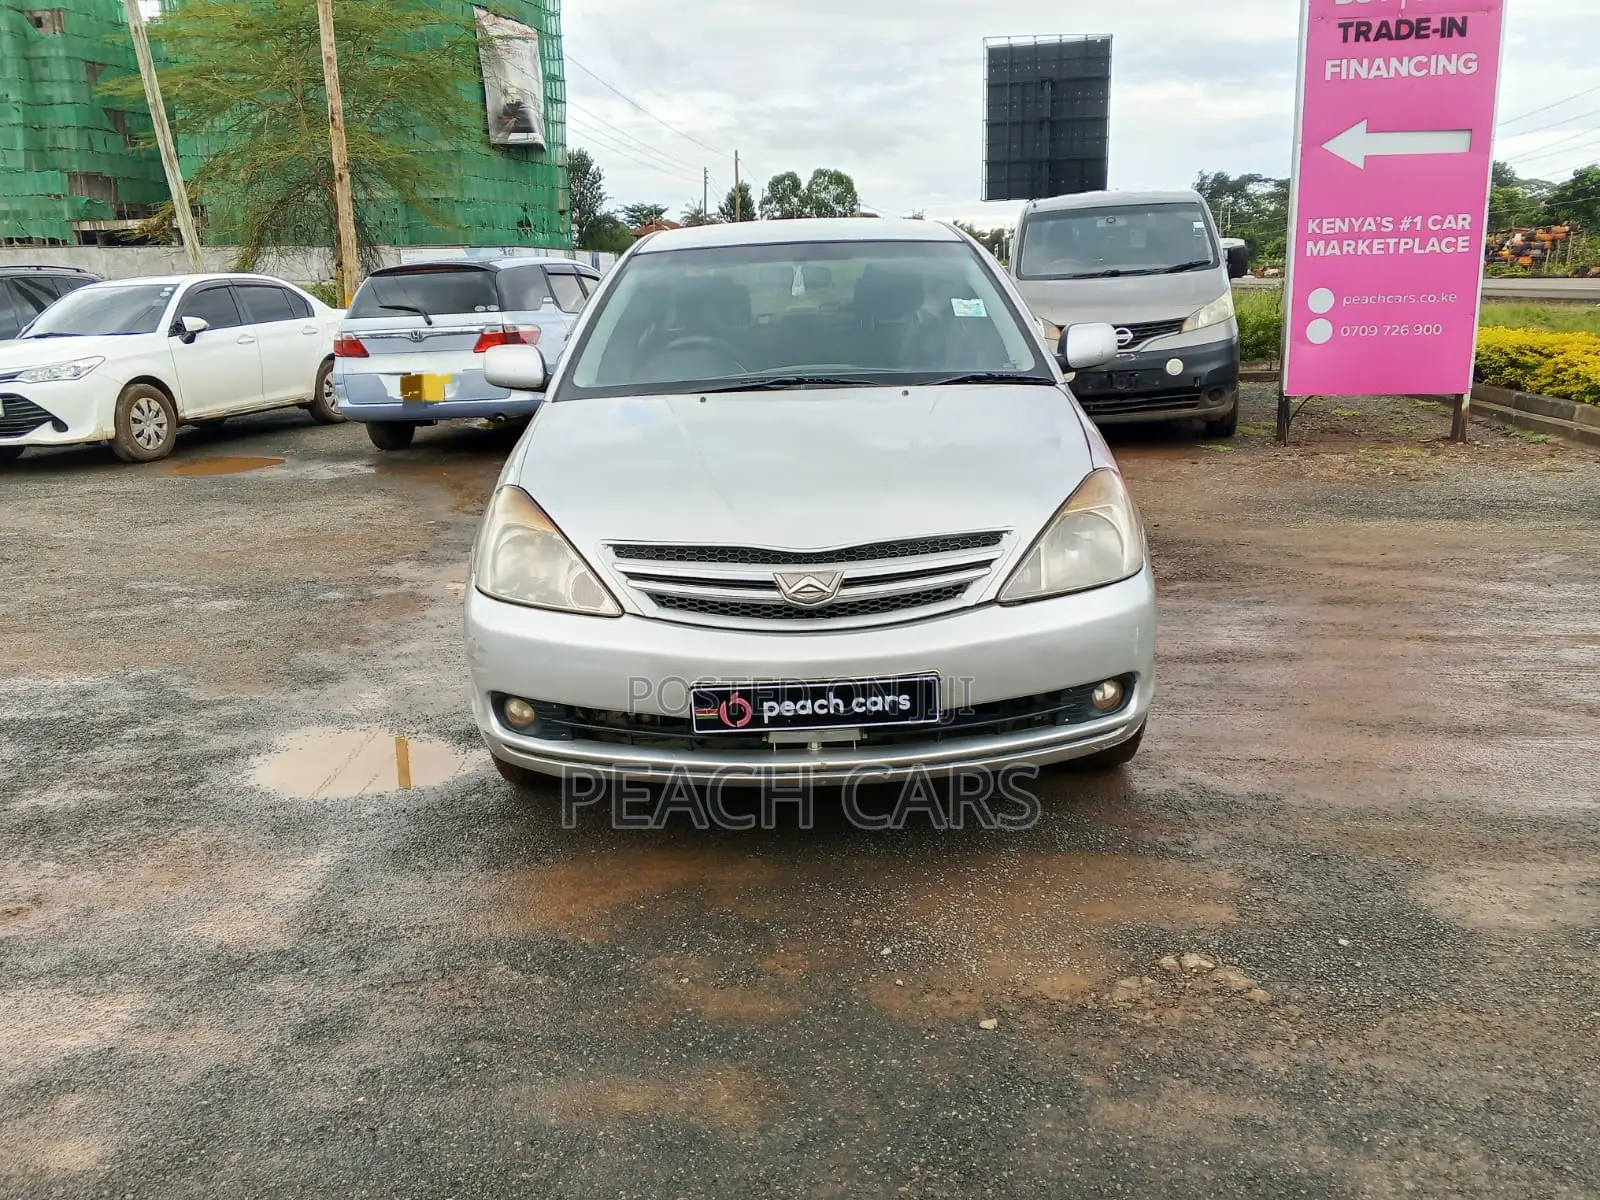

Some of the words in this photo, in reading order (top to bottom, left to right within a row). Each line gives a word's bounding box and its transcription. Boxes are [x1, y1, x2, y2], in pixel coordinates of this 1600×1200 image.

[1338, 16, 1468, 44] TRADE-IN
[1325, 53, 1478, 81] FINANCING
[1398, 215, 1423, 232] #1
[1427, 213, 1472, 231] CAR
[1306, 236, 1470, 257] MARKETPLACE
[1343, 292, 1457, 307] peachcars.co.ke
[1340, 325, 1378, 337] 0709
[1383, 324, 1409, 336] 726
[1413, 323, 1442, 335] 900
[763, 692, 844, 724] peach
[851, 693, 911, 712] cars
